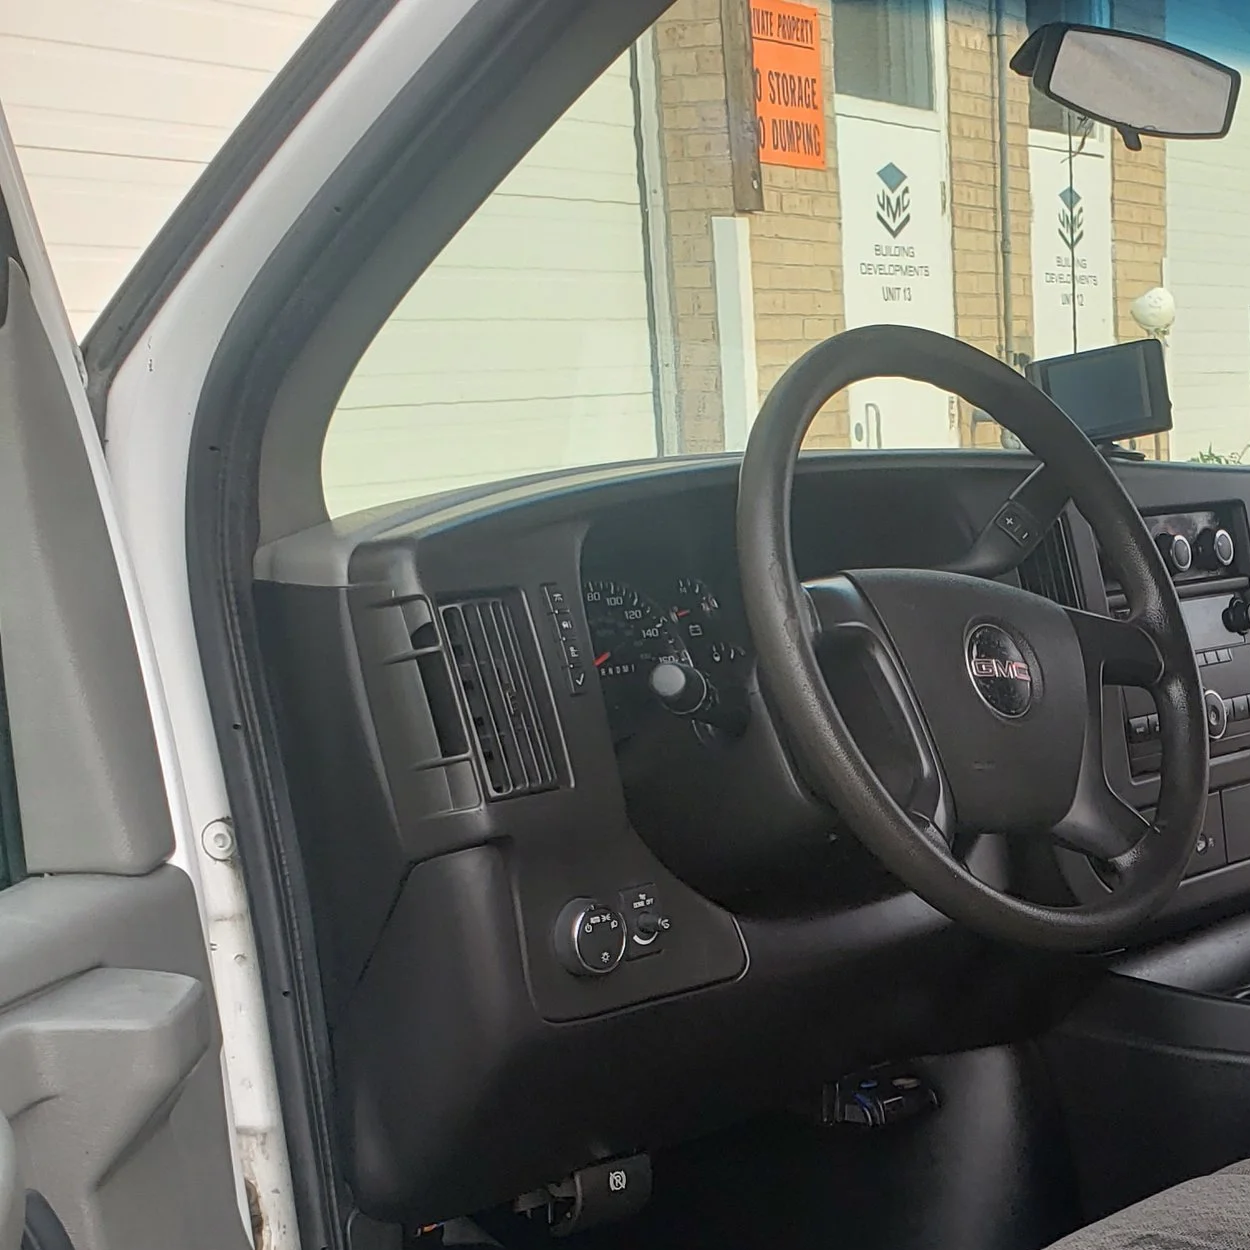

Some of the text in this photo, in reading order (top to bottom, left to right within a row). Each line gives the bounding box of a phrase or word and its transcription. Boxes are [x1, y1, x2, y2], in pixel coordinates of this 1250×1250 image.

[752, 8, 814, 45] IVATE PROPERTY
[768, 70, 818, 110] STORAGE
[772, 118, 821, 157] DUMPING
[874, 244, 915, 258] BUILDING
[1056, 255, 1087, 269] BUILING
[859, 262, 930, 277] DEVELOPMENTS
[1044, 272, 1098, 286] DEVELOMENTS
[881, 286, 912, 301] UNIT 13
[587, 591, 601, 602] 80
[606, 596, 623, 606] 100
[624, 609, 642, 620] 120
[641, 627, 659, 638] 140
[971, 658, 1031, 682] GMC
